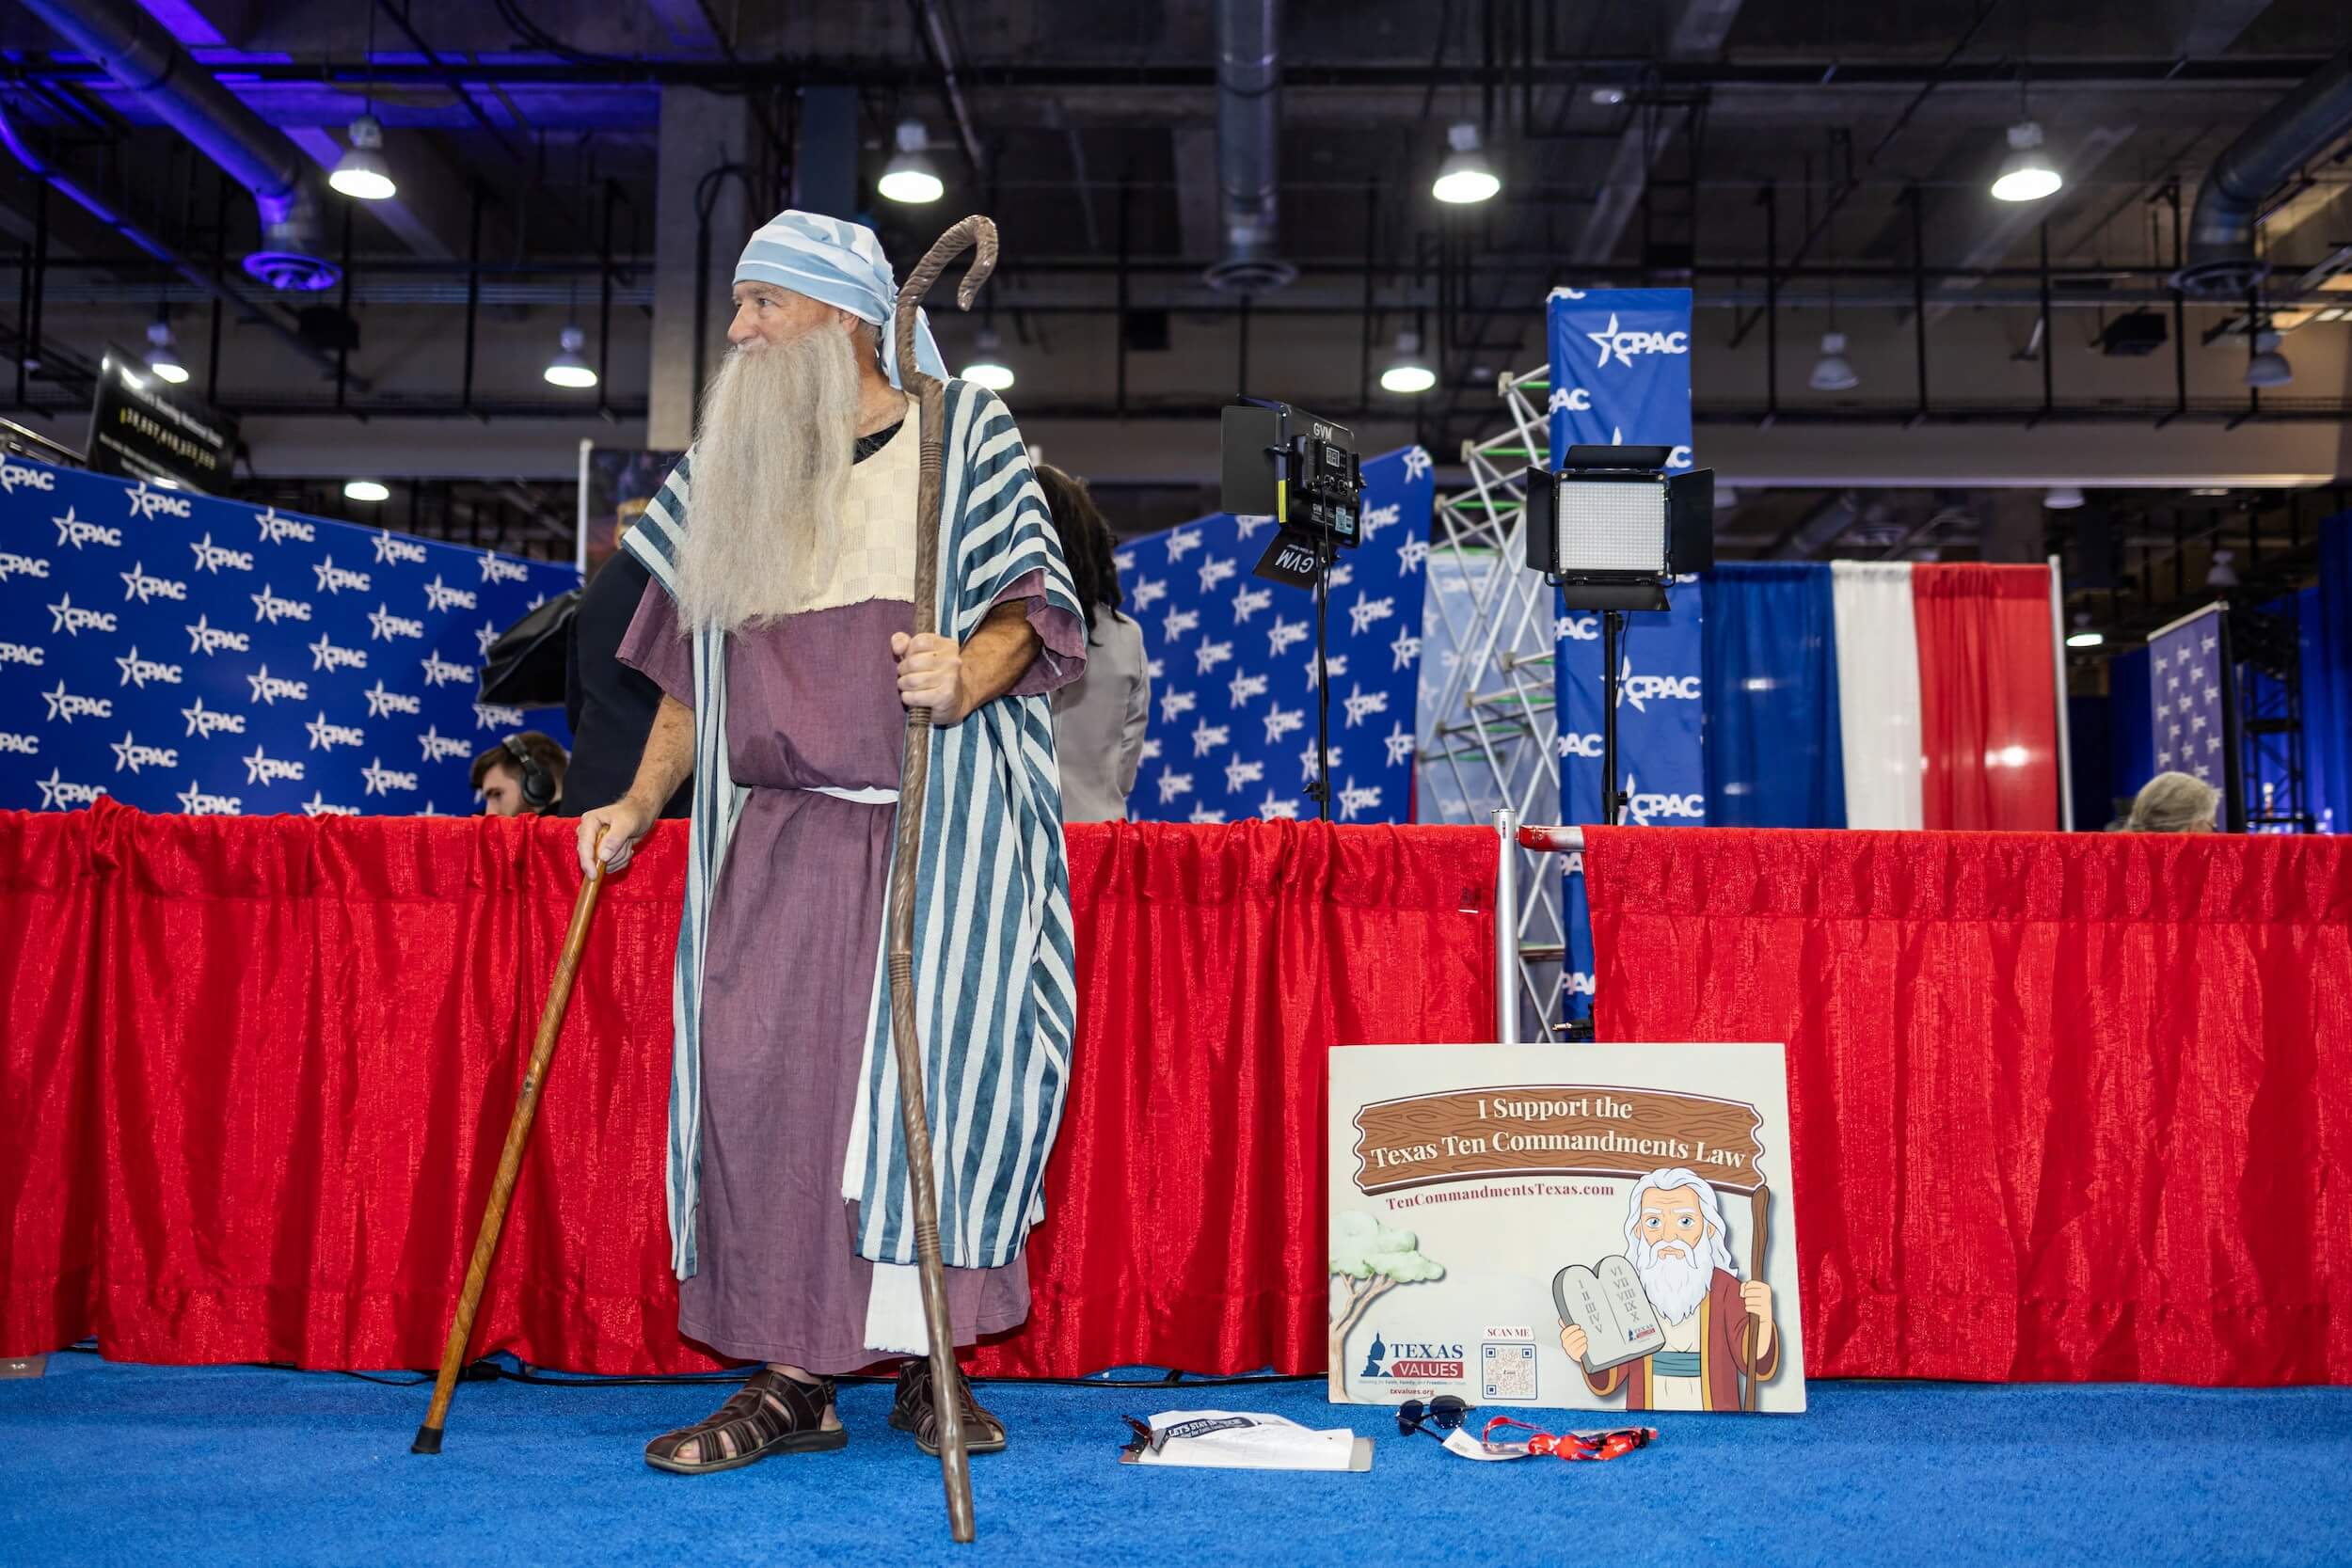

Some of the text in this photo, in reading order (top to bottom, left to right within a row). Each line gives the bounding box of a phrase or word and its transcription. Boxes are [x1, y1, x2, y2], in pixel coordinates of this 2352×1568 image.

[1613, 331, 1688, 354] CPAC
[1313, 422, 1332, 441] GVM
[1275, 549, 1314, 573] GVM
[1625, 676, 1701, 699] CPAC
[0, 734, 40, 754] PAC
[1630, 794, 1705, 817] CPAC
[1478, 1097, 1632, 1121] I Support the
[1371, 1131, 1746, 1168] Texas Ten Commandments Law
[1386, 1182, 1614, 1211] TenCommandmentsTexas.com
[1487, 1328, 1529, 1338] SCAN ME
[1391, 1343, 1464, 1359] TEXAS
[1400, 1363, 1458, 1377] VALUES
[1391, 1387, 1435, 1397] txvalues.org
